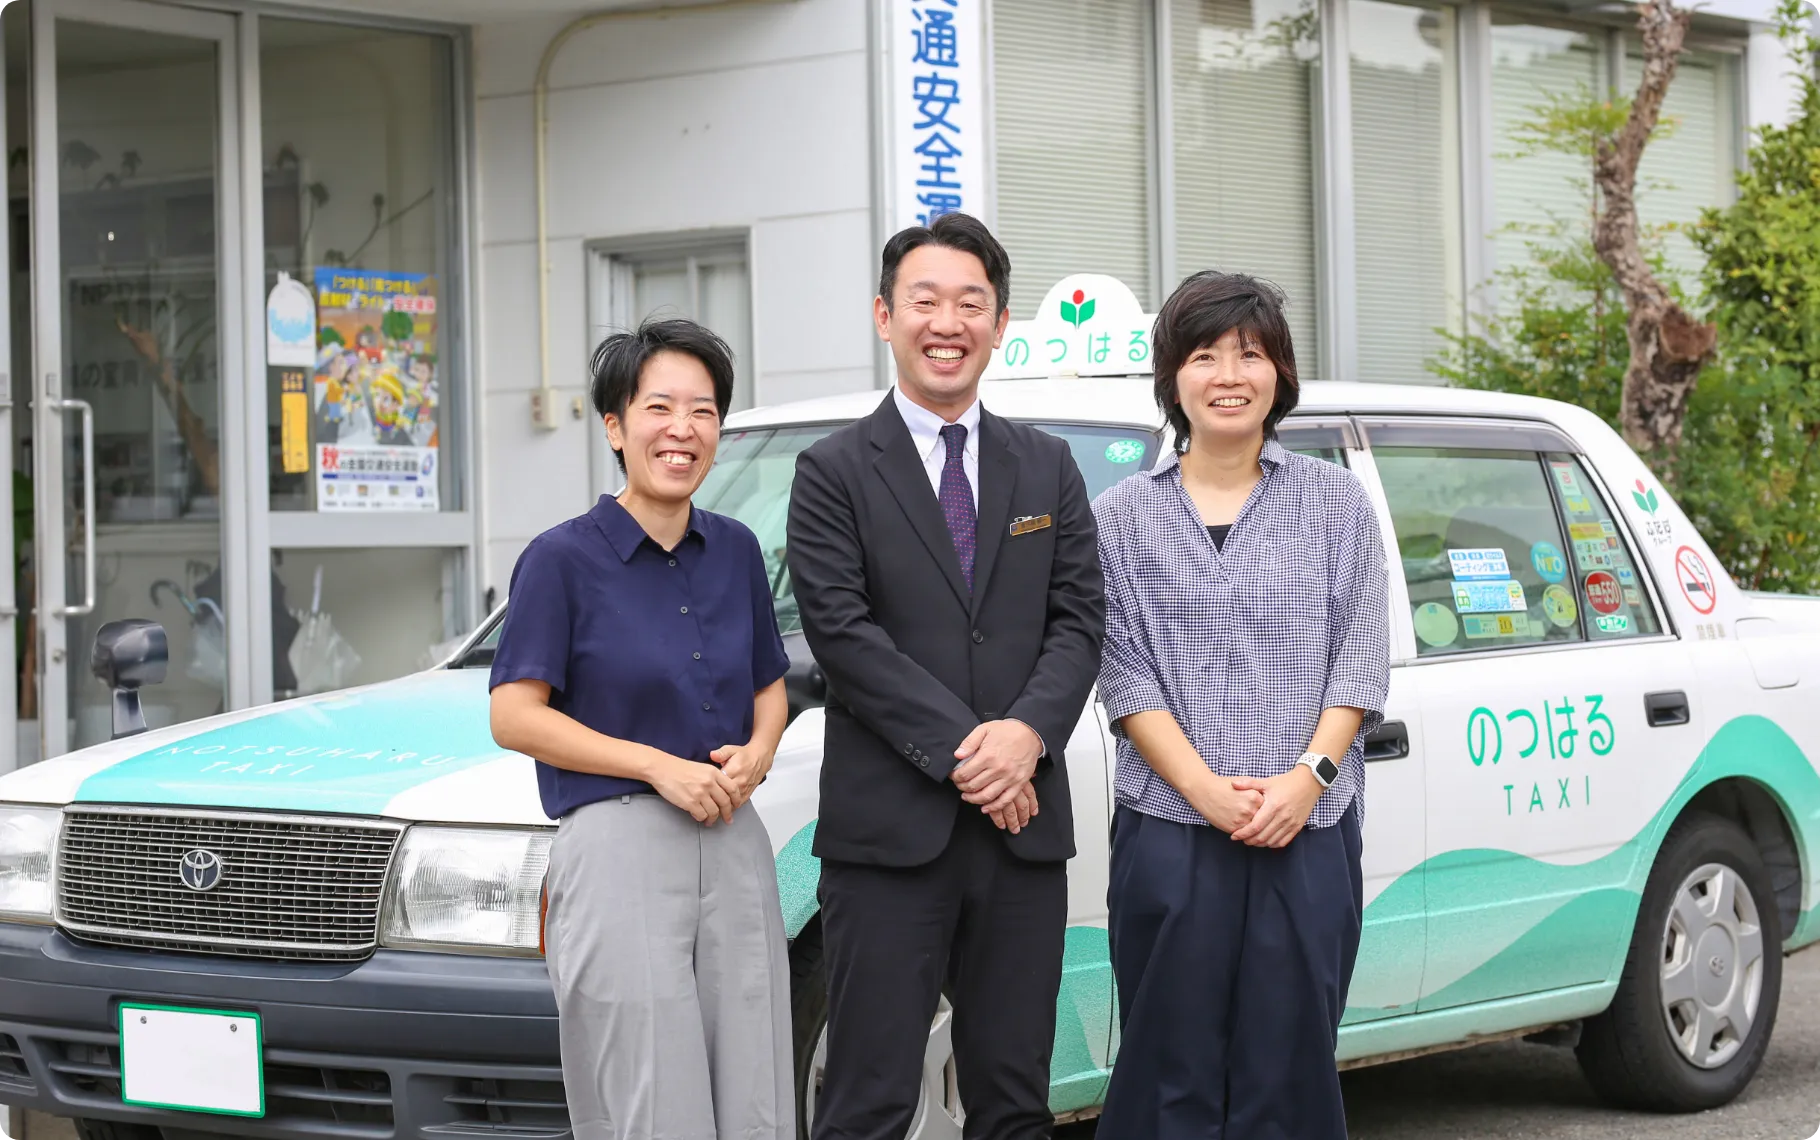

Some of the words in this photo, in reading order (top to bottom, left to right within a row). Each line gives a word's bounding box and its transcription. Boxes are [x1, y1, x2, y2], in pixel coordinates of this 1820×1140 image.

[911, 0, 962, 228] 通安全
[1005, 330, 1149, 366] のつはる
[1601, 581, 1620, 605] 550
[1467, 694, 1615, 766] のつはる
[155, 745, 456, 767] NOTSUHARU
[199, 761, 315, 777] TAXI
[1503, 775, 1590, 816] TAXI
